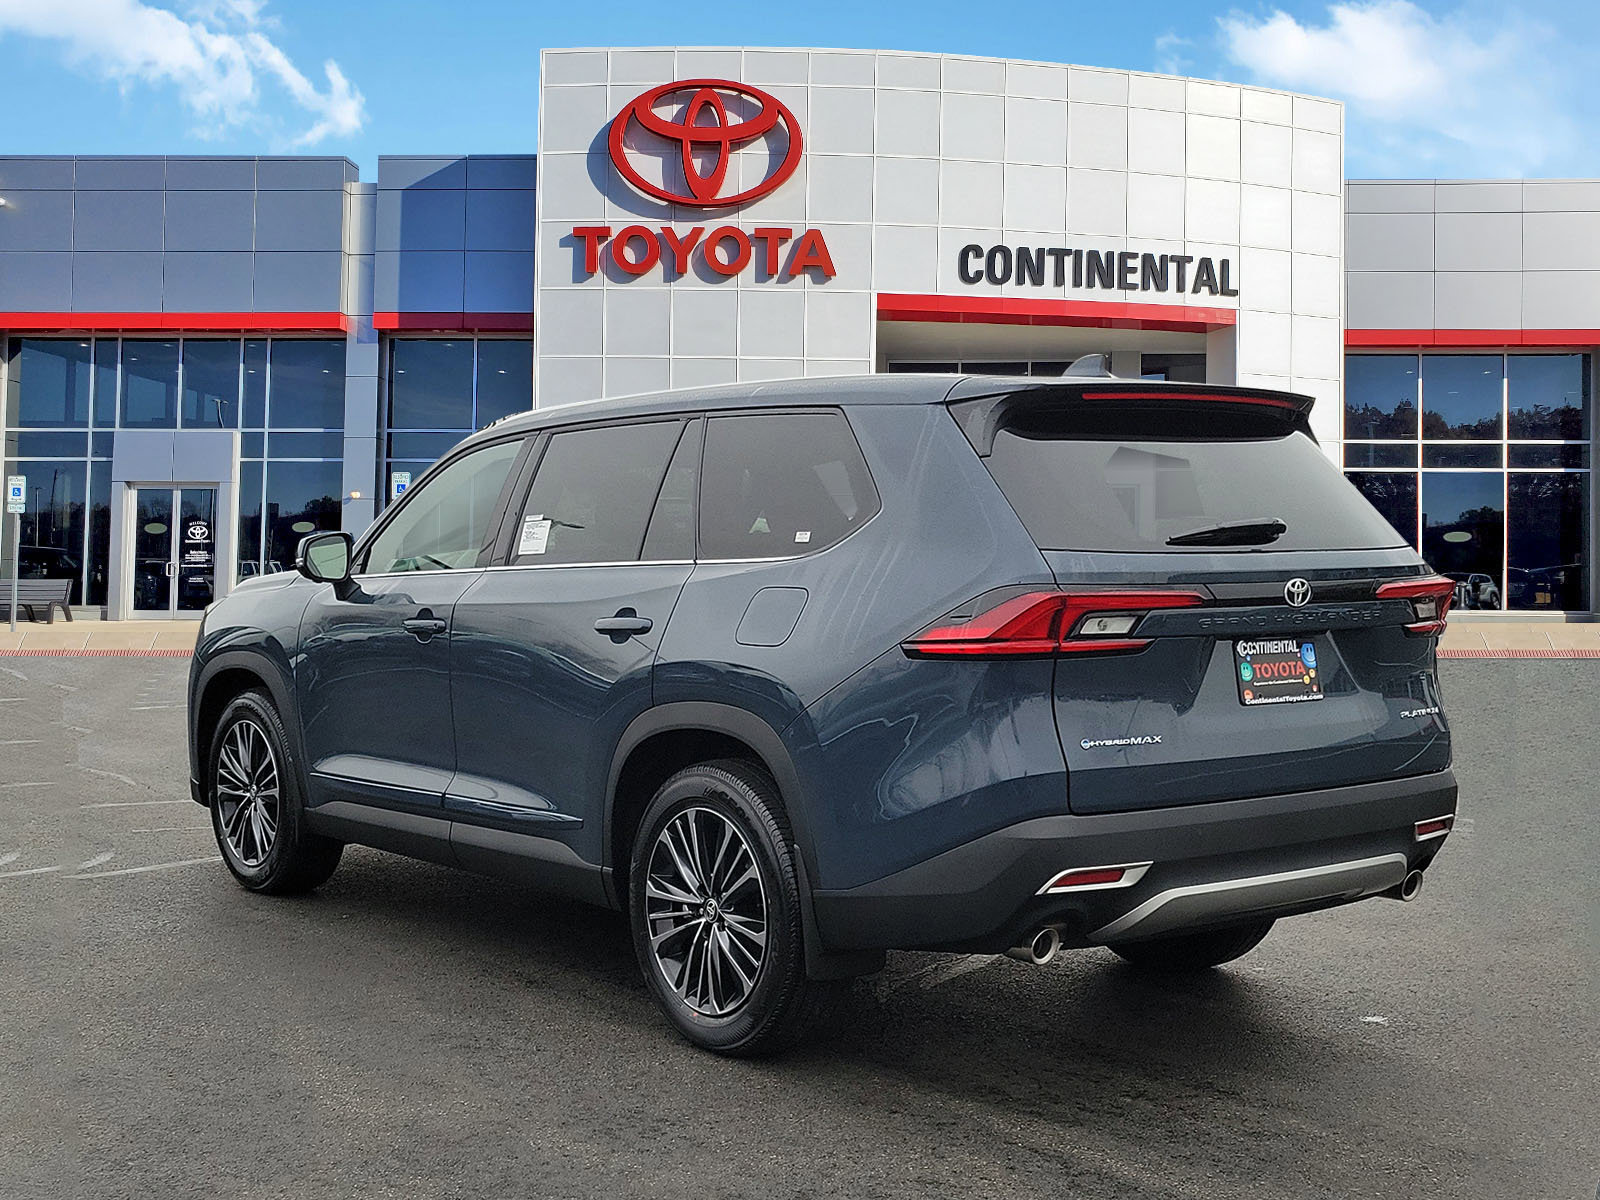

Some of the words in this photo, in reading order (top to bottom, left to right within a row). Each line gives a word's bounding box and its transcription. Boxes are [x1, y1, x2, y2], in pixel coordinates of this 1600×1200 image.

[572, 225, 836, 277] TOYOTA
[958, 244, 1239, 297] CONTINENTAL
[1236, 639, 1300, 657] CONTINENTAL
[1252, 660, 1306, 678] TOYOTA
